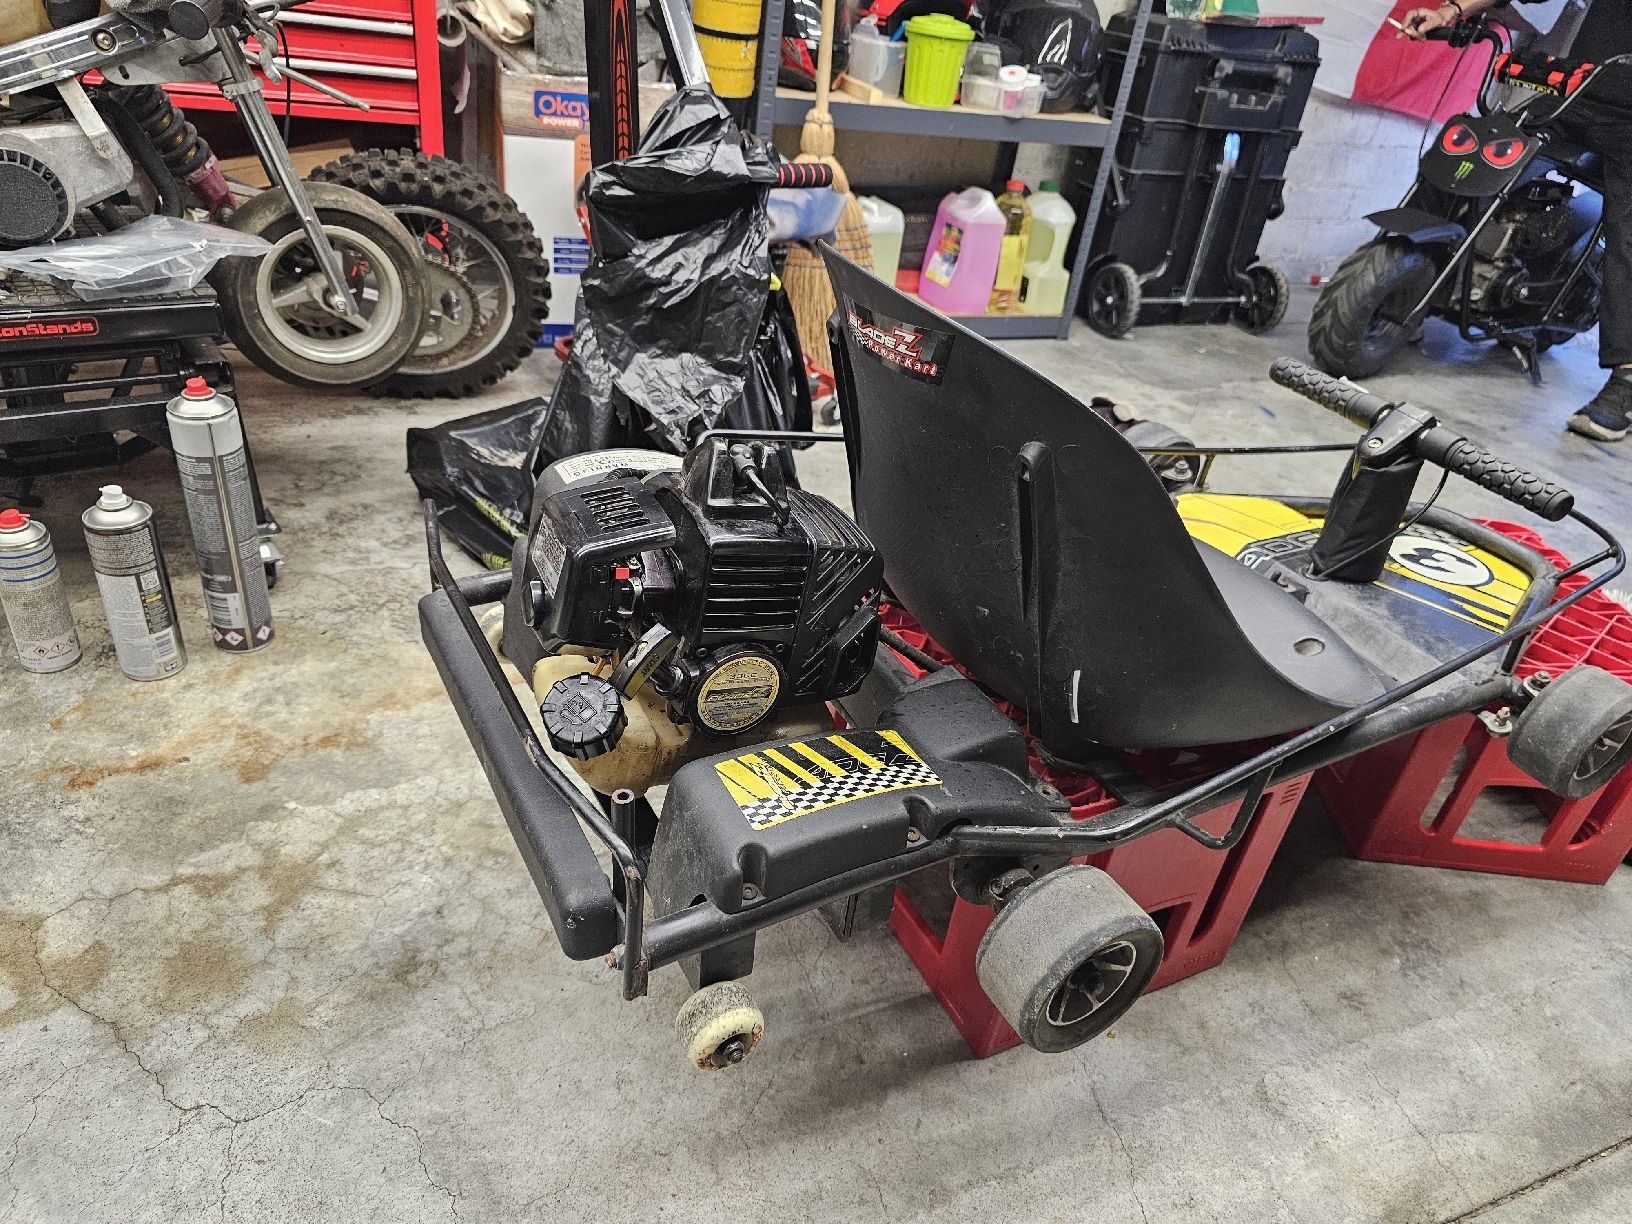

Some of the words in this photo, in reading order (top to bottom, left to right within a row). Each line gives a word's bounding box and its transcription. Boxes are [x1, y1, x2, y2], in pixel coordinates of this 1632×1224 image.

[543, 116, 580, 127] POWER
[0, 321, 94, 337] onStands
[904, 358, 938, 377] Kart
